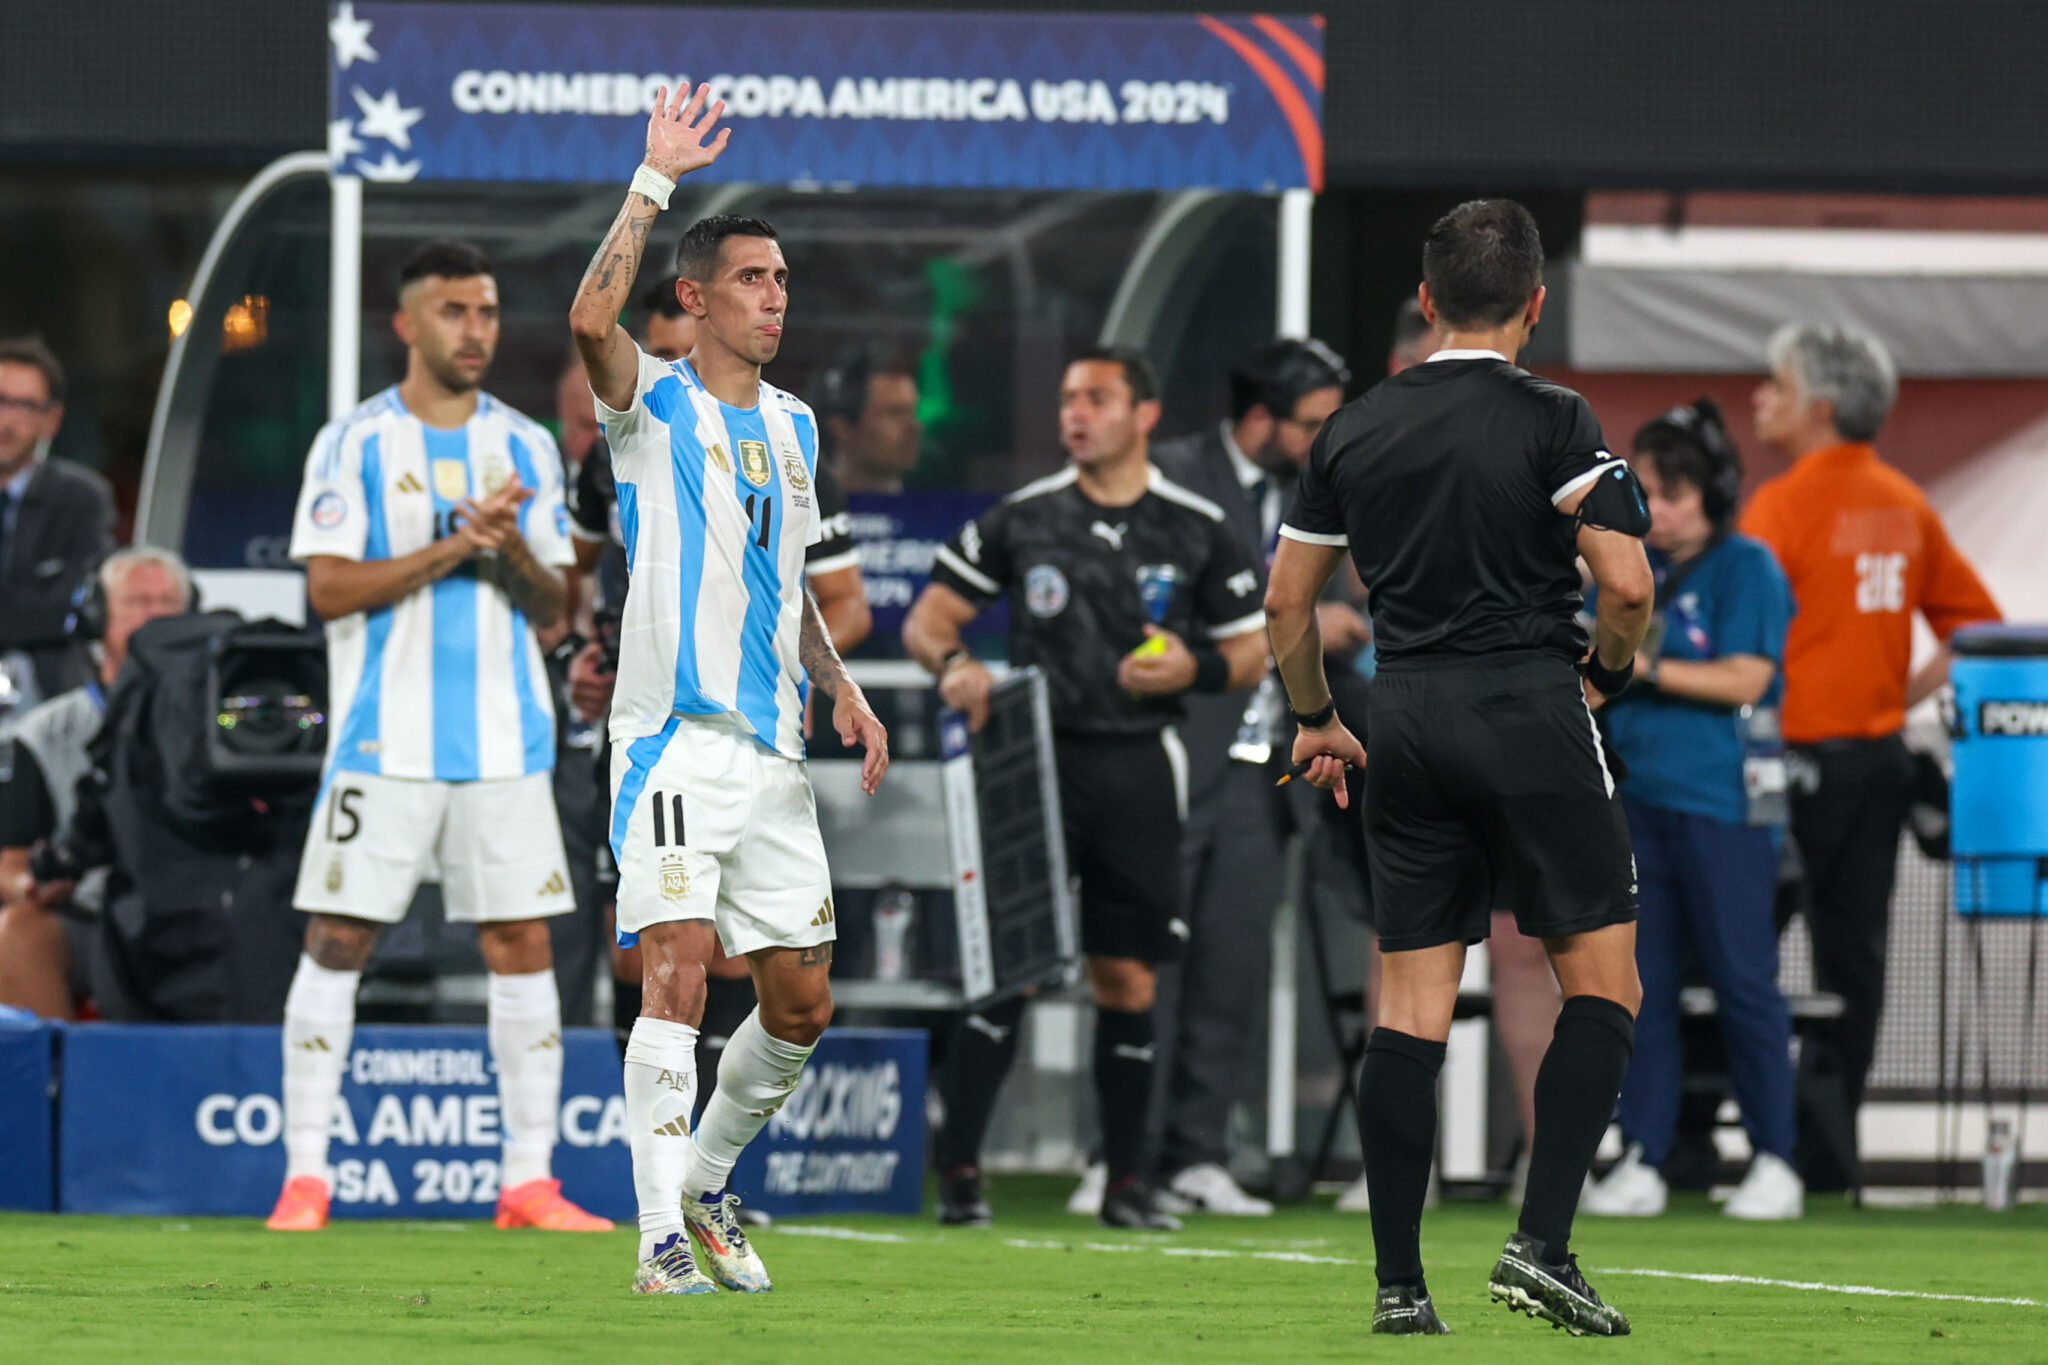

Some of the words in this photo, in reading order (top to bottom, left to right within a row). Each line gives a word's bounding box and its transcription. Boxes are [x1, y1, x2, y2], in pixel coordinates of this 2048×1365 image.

[706, 73, 825, 118] COPA
[829, 77, 1028, 121] AMERICA
[1030, 80, 1118, 125] USA
[1121, 80, 1229, 125] 2024
[745, 493, 772, 552] 11
[326, 786, 365, 843] 15
[652, 791, 686, 847] 11
[352, 1049, 489, 1085] CONMEBOL
[195, 1093, 359, 1146] COA
[367, 1093, 632, 1147] AMECA
[413, 1158, 500, 1204] 202
